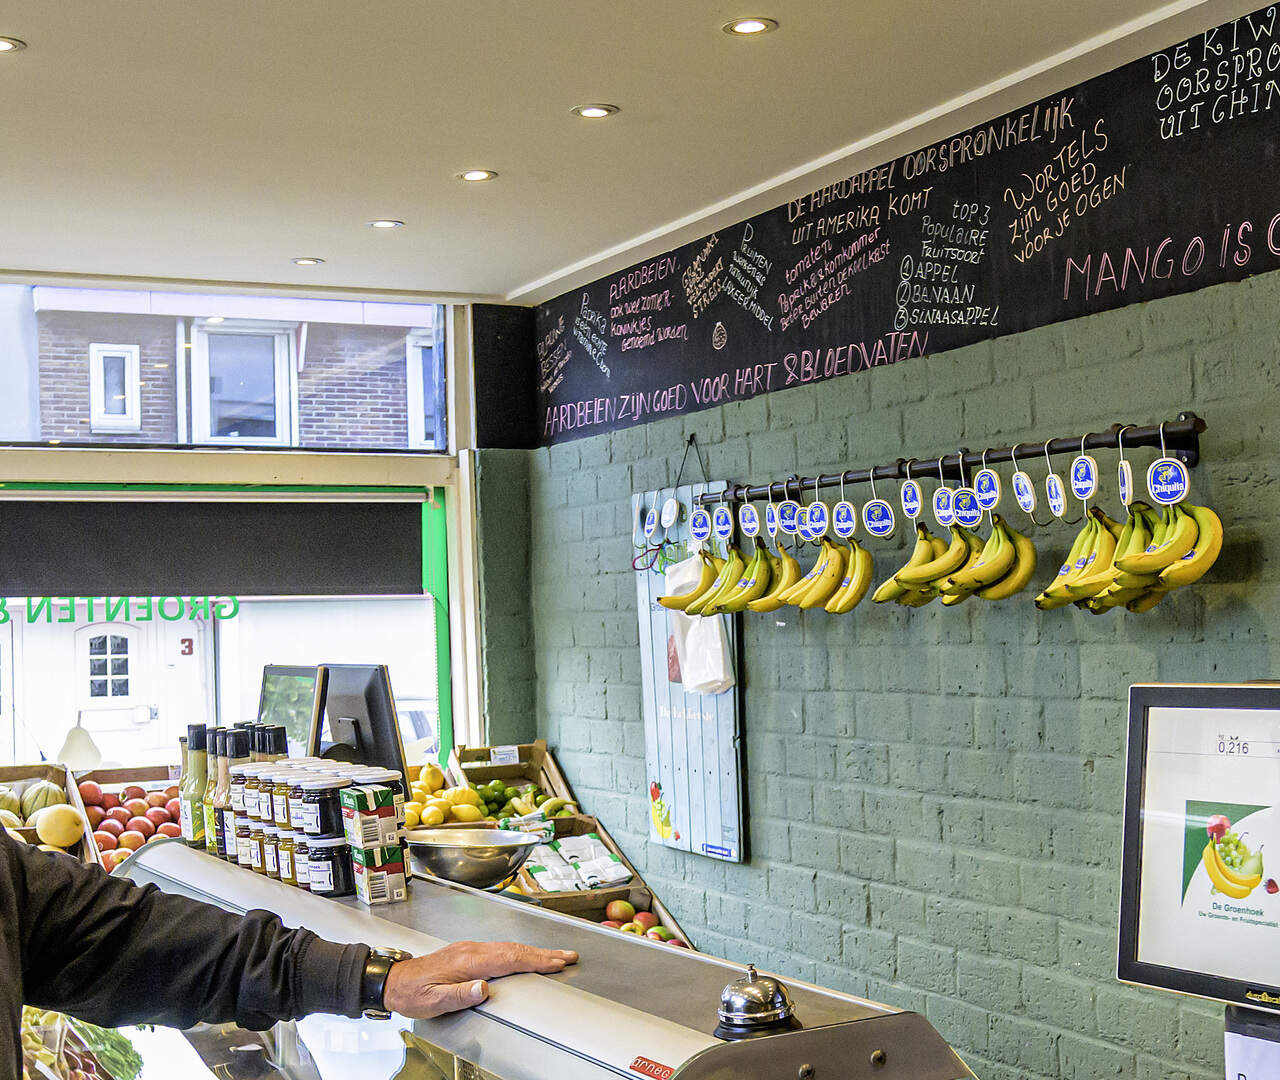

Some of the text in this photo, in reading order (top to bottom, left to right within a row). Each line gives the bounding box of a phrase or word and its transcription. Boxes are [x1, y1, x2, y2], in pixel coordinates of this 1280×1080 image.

[1151, 42, 1191, 83] DE
[1160, 102, 1205, 140] UIT
[1004, 118, 1108, 210] WORTELS
[787, 196, 806, 223] DE
[810, 160, 896, 212] AARDAPPEL
[888, 186, 934, 220] KOMT
[1046, 163, 1097, 212] GOED
[979, 205, 991, 226] 3
[1014, 228, 1054, 263] VOOR
[1076, 165, 1127, 217] OGEN
[914, 262, 959, 283] APPEL
[1063, 240, 1206, 301] MANGO
[913, 284, 976, 304] BANAAN
[544, 397, 617, 436] AARDBEIEN
[653, 383, 688, 412] GOED
[691, 376, 731, 404] VOOR
[734, 361, 779, 396] HART
[1152, 482, 1184, 494] Chiquita
[1212, 902, 1222, 911] De
